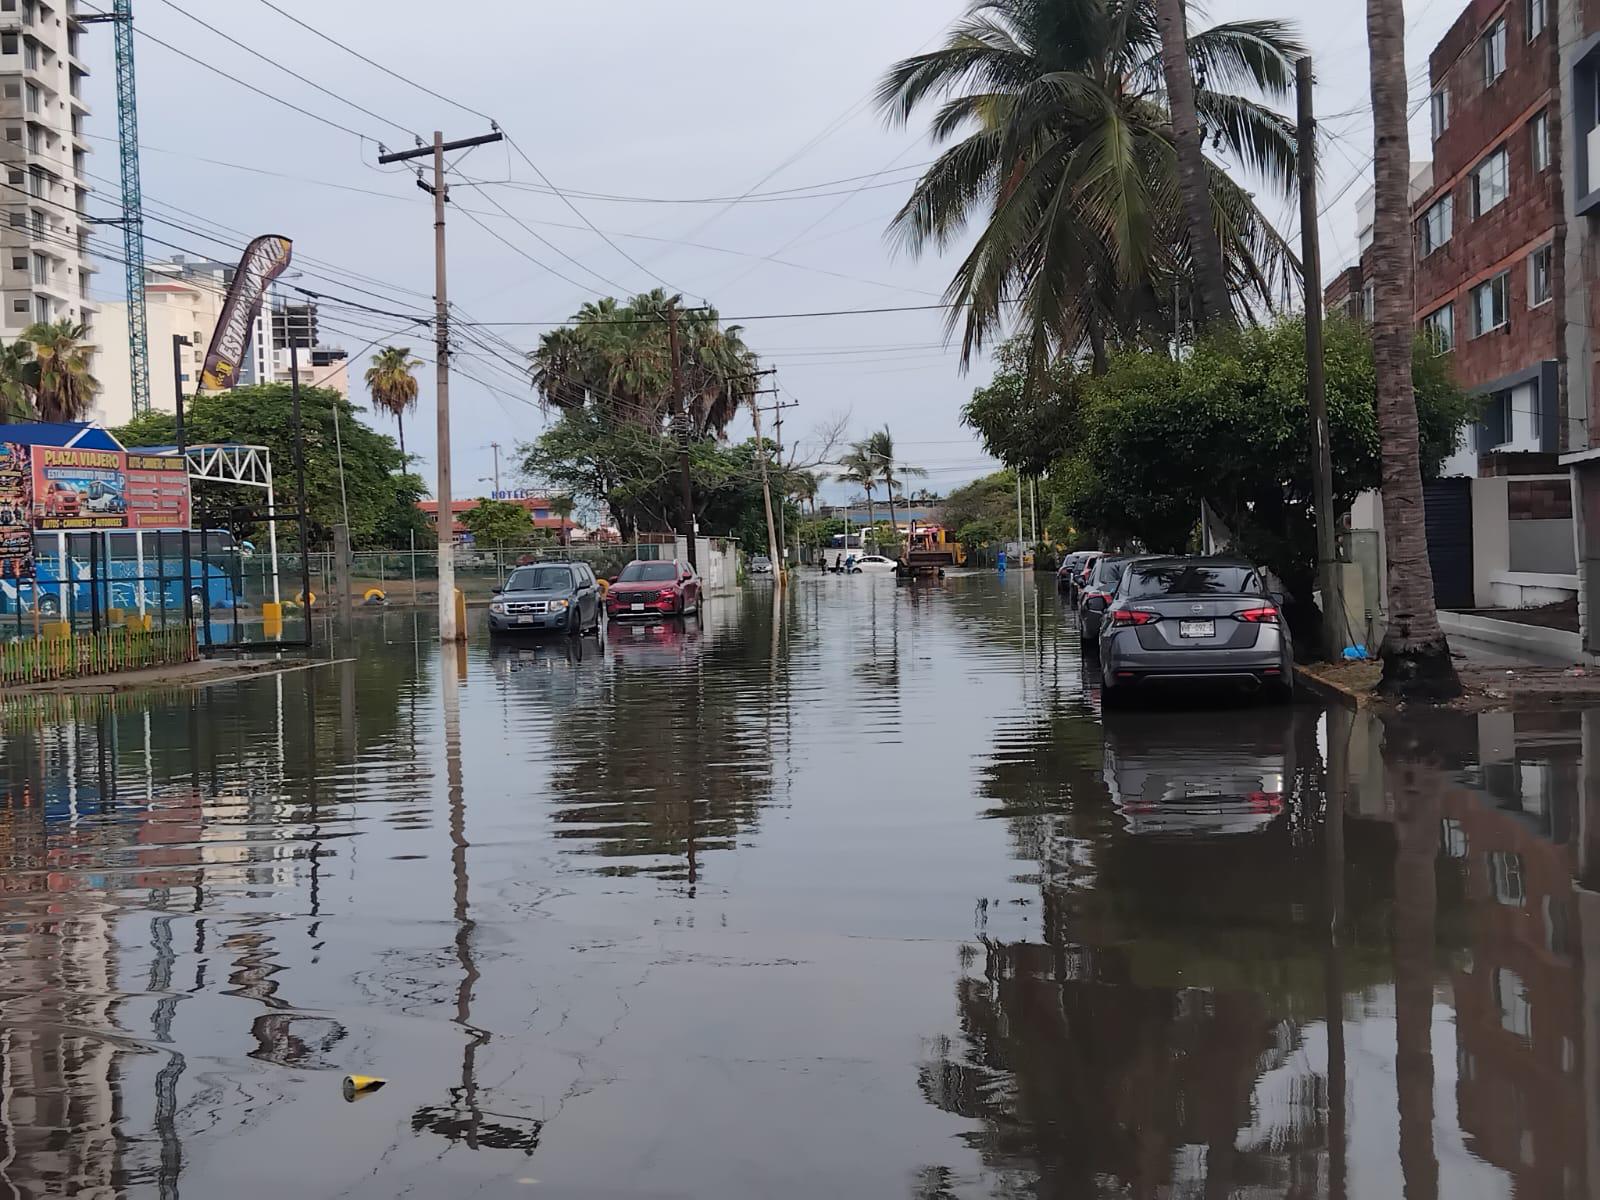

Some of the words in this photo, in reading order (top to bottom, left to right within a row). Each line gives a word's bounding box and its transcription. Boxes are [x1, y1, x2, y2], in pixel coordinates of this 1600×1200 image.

[44, 449, 79, 466] PLAZA
[80, 451, 120, 469] VIAJERO
[491, 490, 526, 499] HOTEL
